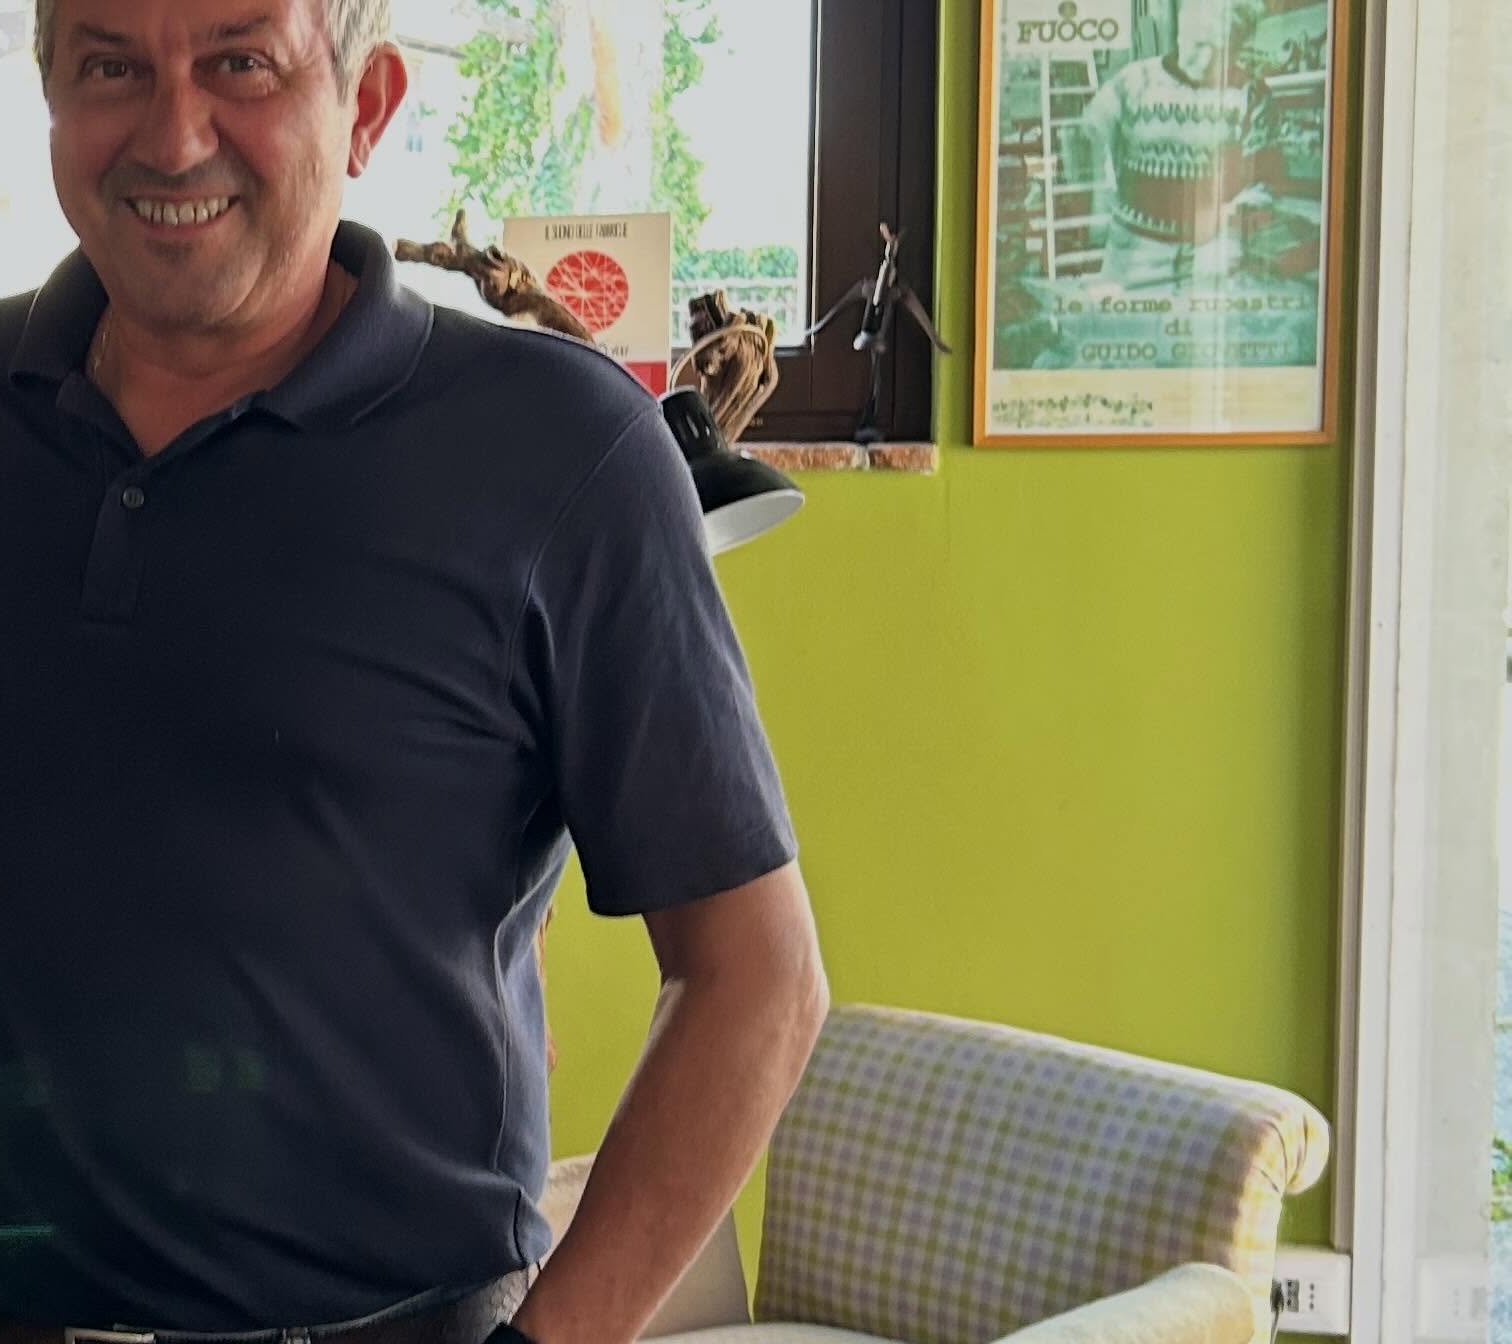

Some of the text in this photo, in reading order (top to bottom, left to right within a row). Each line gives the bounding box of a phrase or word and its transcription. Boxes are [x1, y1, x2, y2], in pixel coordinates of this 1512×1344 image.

[1017, 18, 1119, 44] FUOCO
[1054, 296, 1083, 315] le
[1099, 295, 1173, 315] forme
[1164, 318, 1193, 337] di
[1081, 342, 1158, 362] GUIDO
